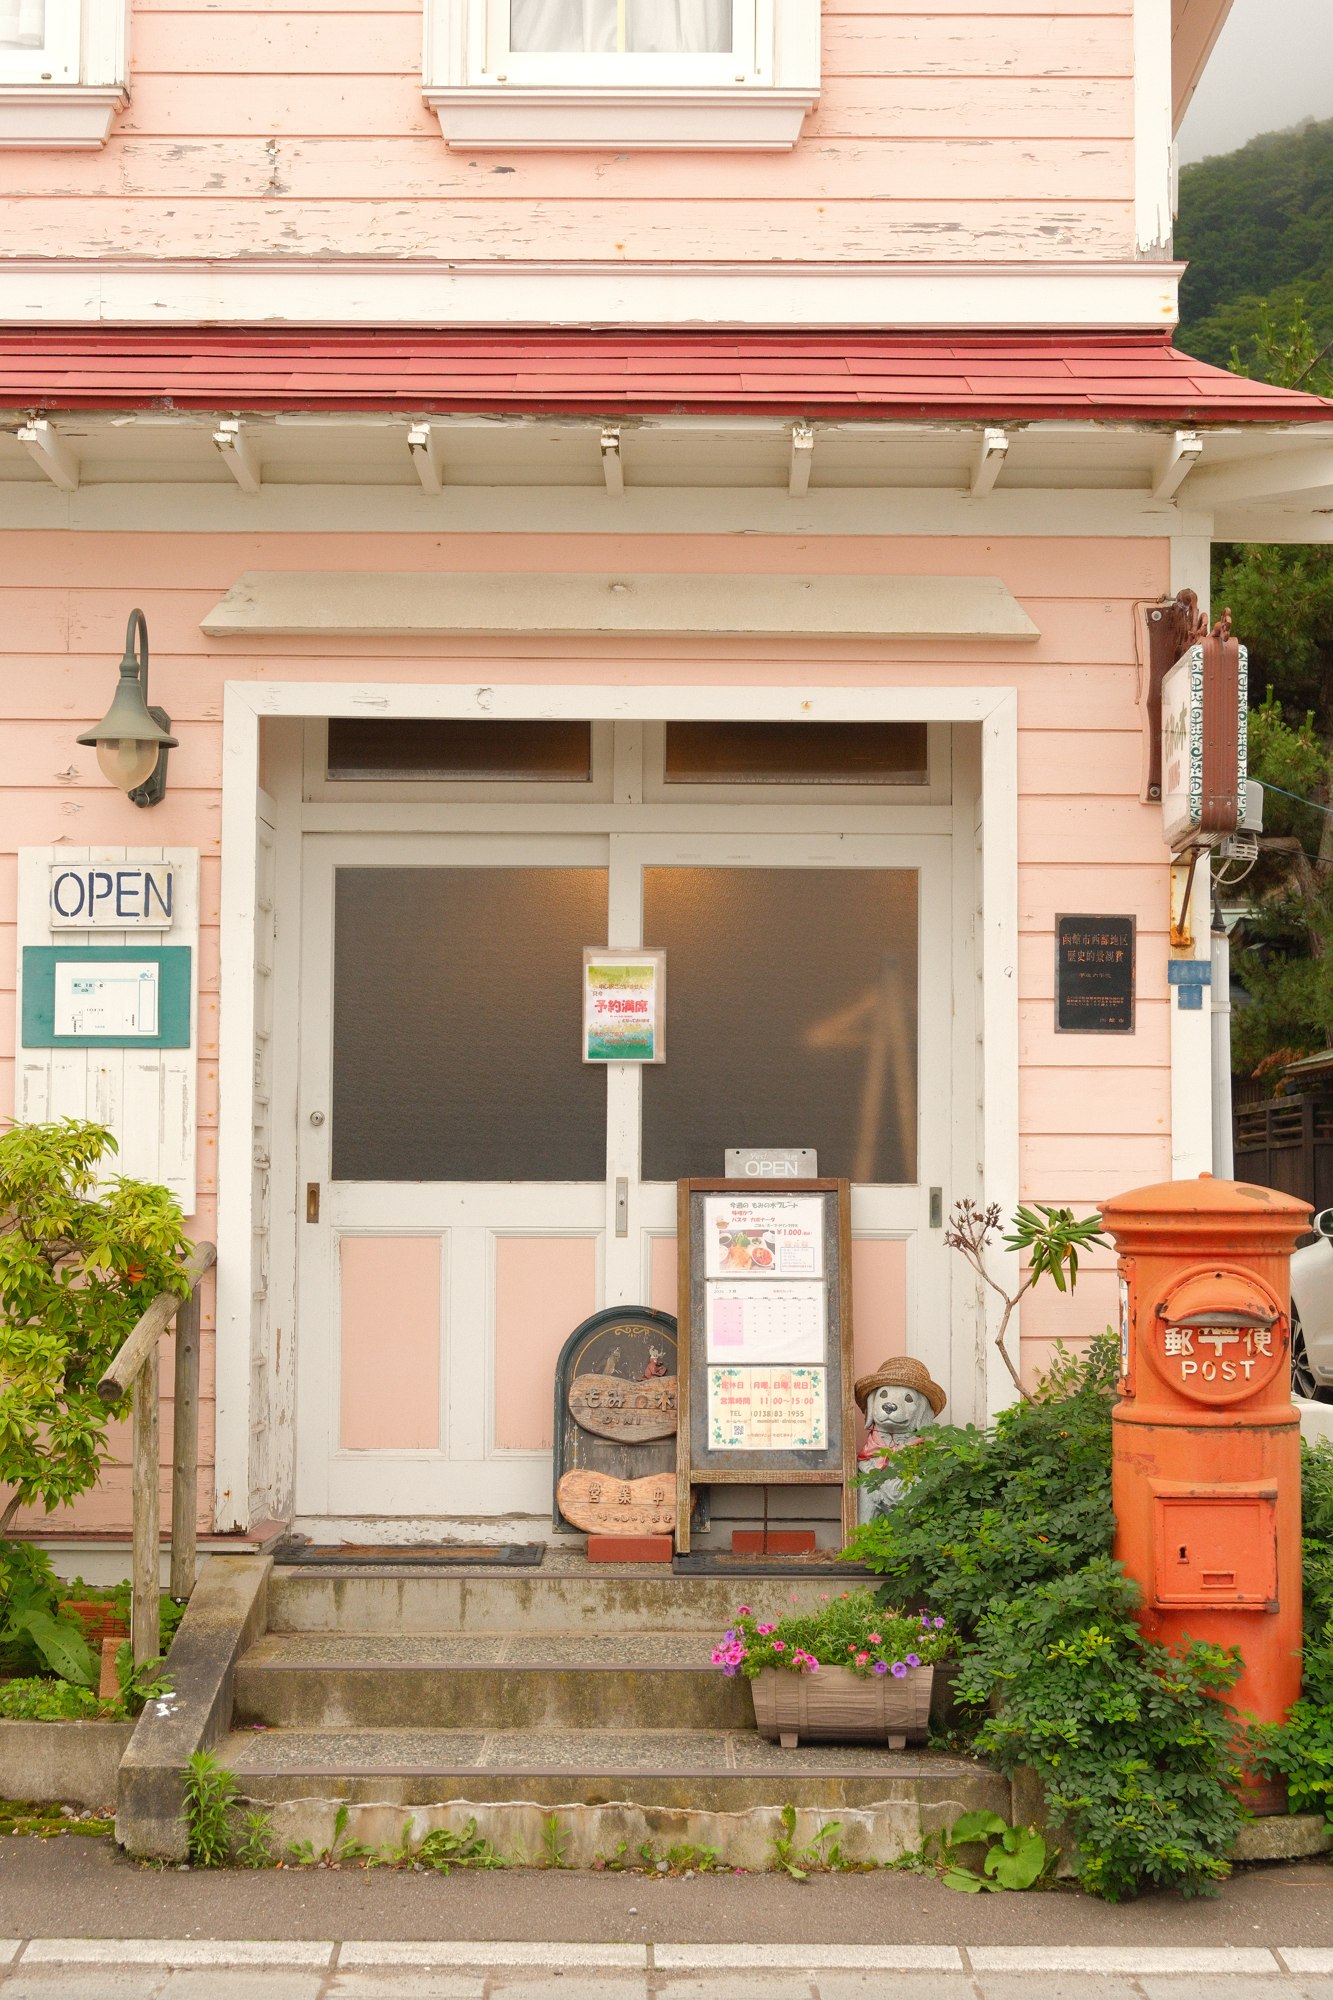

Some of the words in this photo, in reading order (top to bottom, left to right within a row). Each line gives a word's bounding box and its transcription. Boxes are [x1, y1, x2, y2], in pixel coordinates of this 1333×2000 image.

[54, 872, 173, 918] OPEN
[595, 999, 648, 1013] 予約満席
[745, 1160, 798, 1176] OPEN
[1181, 1360, 1256, 1381] POST
[720, 1397, 751, 1405] 営業時間
[588, 1482, 664, 1507] 営業中
